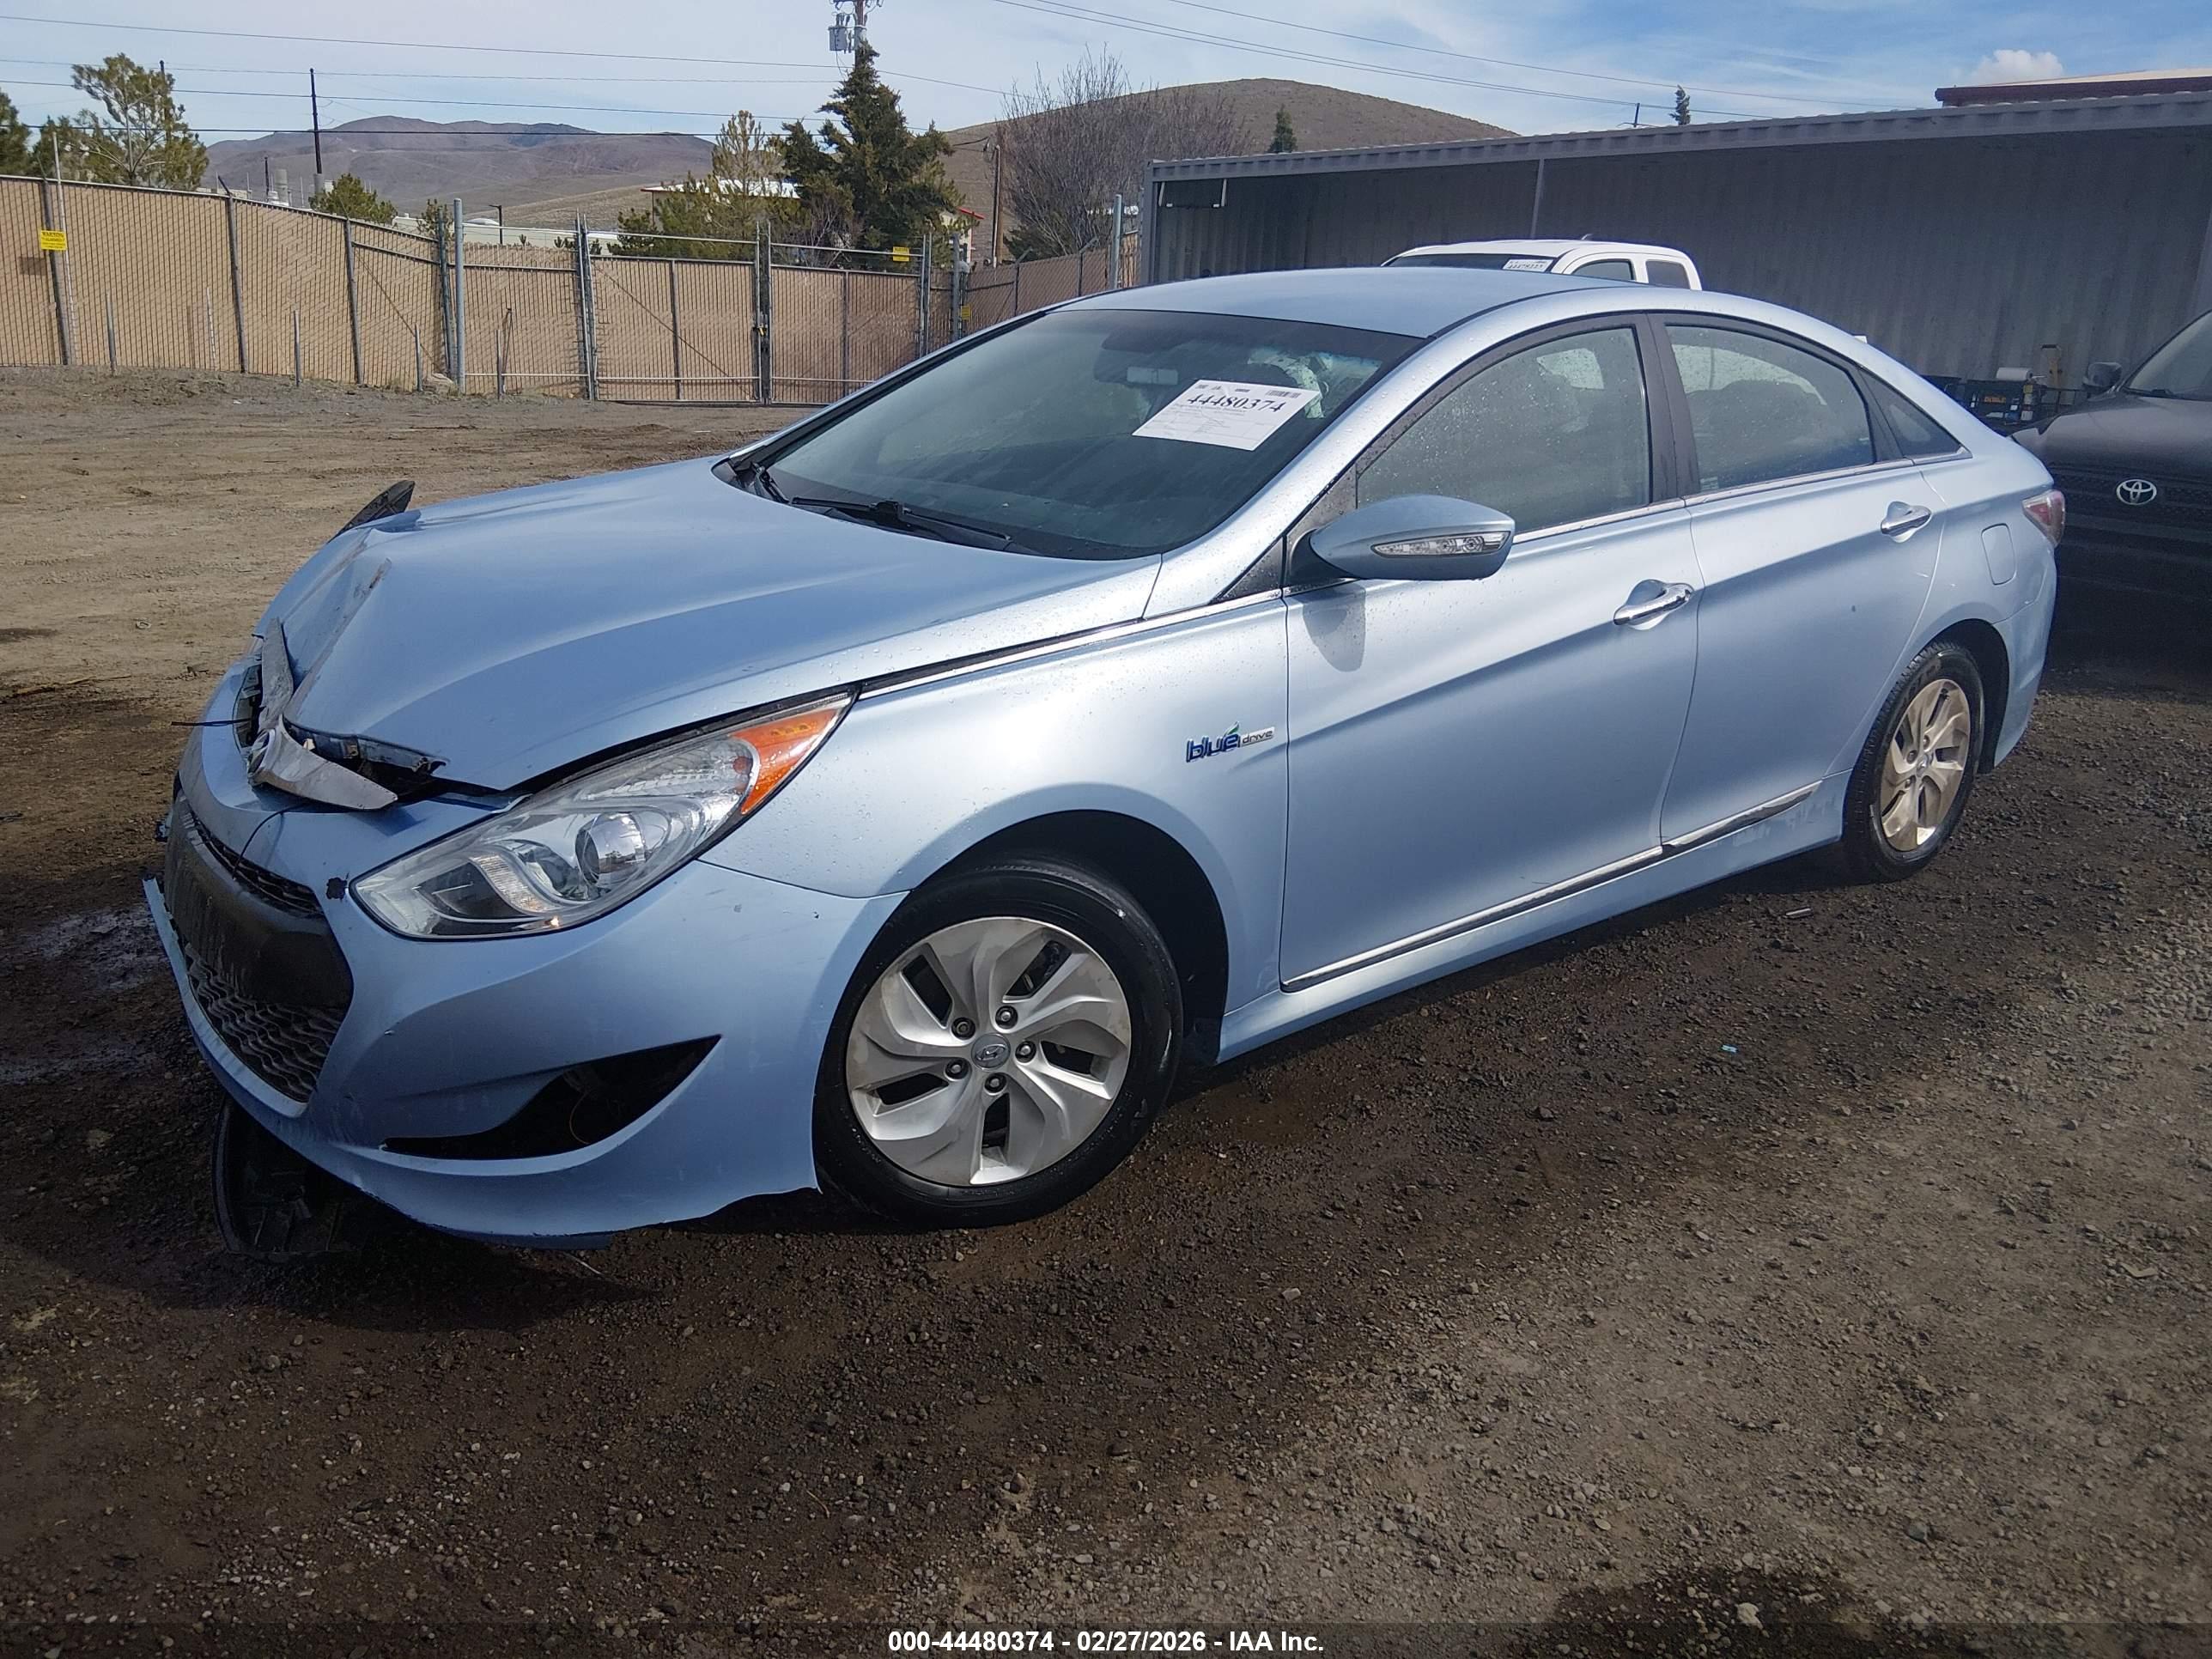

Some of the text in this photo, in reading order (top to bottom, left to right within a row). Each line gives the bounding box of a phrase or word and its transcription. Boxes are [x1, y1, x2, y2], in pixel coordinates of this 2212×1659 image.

[1187, 393, 1287, 413] 44480374
[1186, 730, 1273, 763] blue drive
